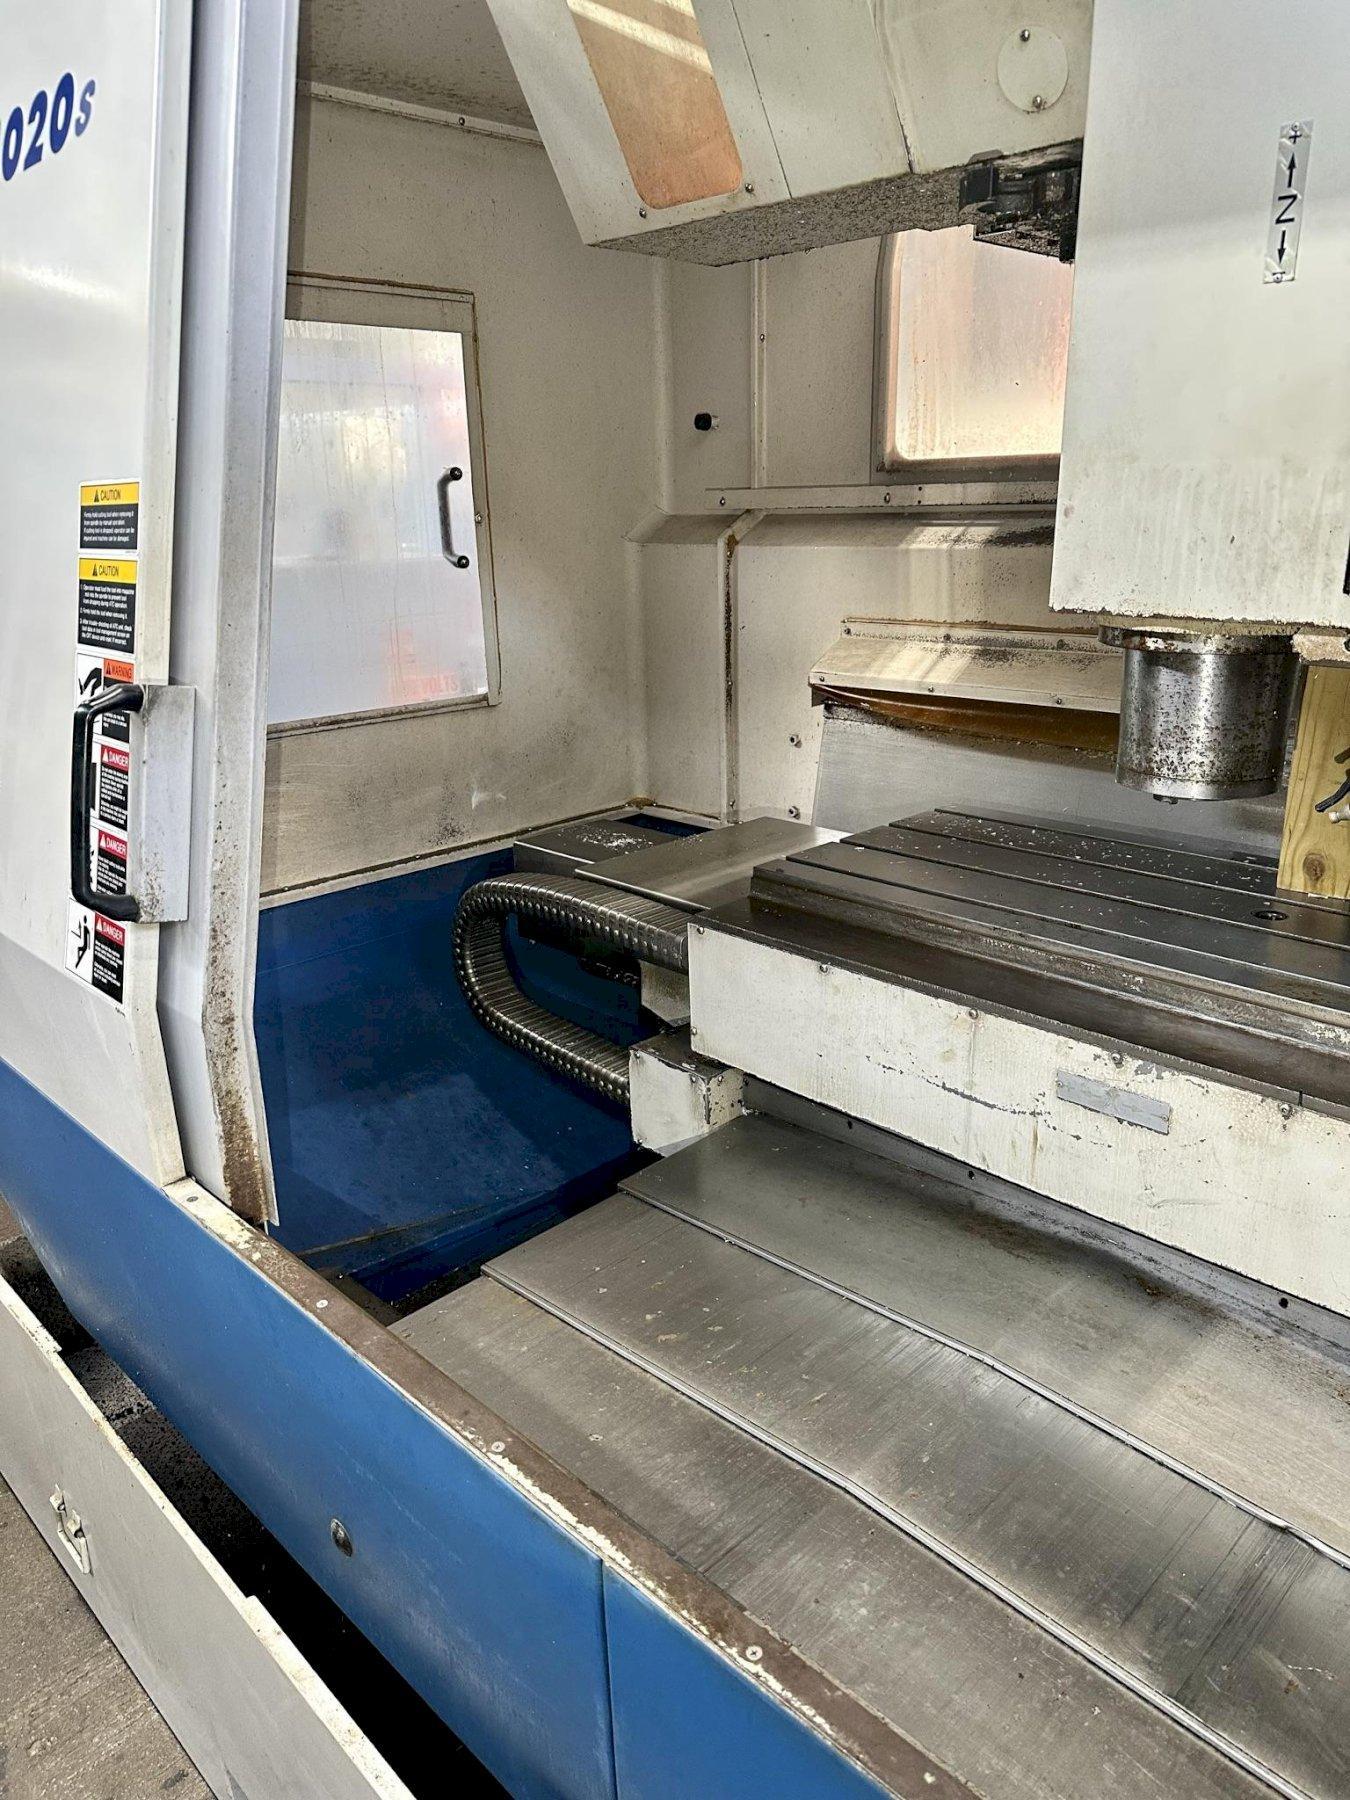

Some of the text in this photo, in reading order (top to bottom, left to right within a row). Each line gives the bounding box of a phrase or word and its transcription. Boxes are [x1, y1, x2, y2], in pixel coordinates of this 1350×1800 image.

[1275, 194, 1298, 225] Z
[100, 489, 121, 502] CAUTION
[98, 565, 120, 577] CAUTION
[112, 664, 132, 679] WARNING
[108, 750, 128, 766] DANGER
[106, 837, 126, 855] DANGER
[102, 921, 123, 941] DANGER
